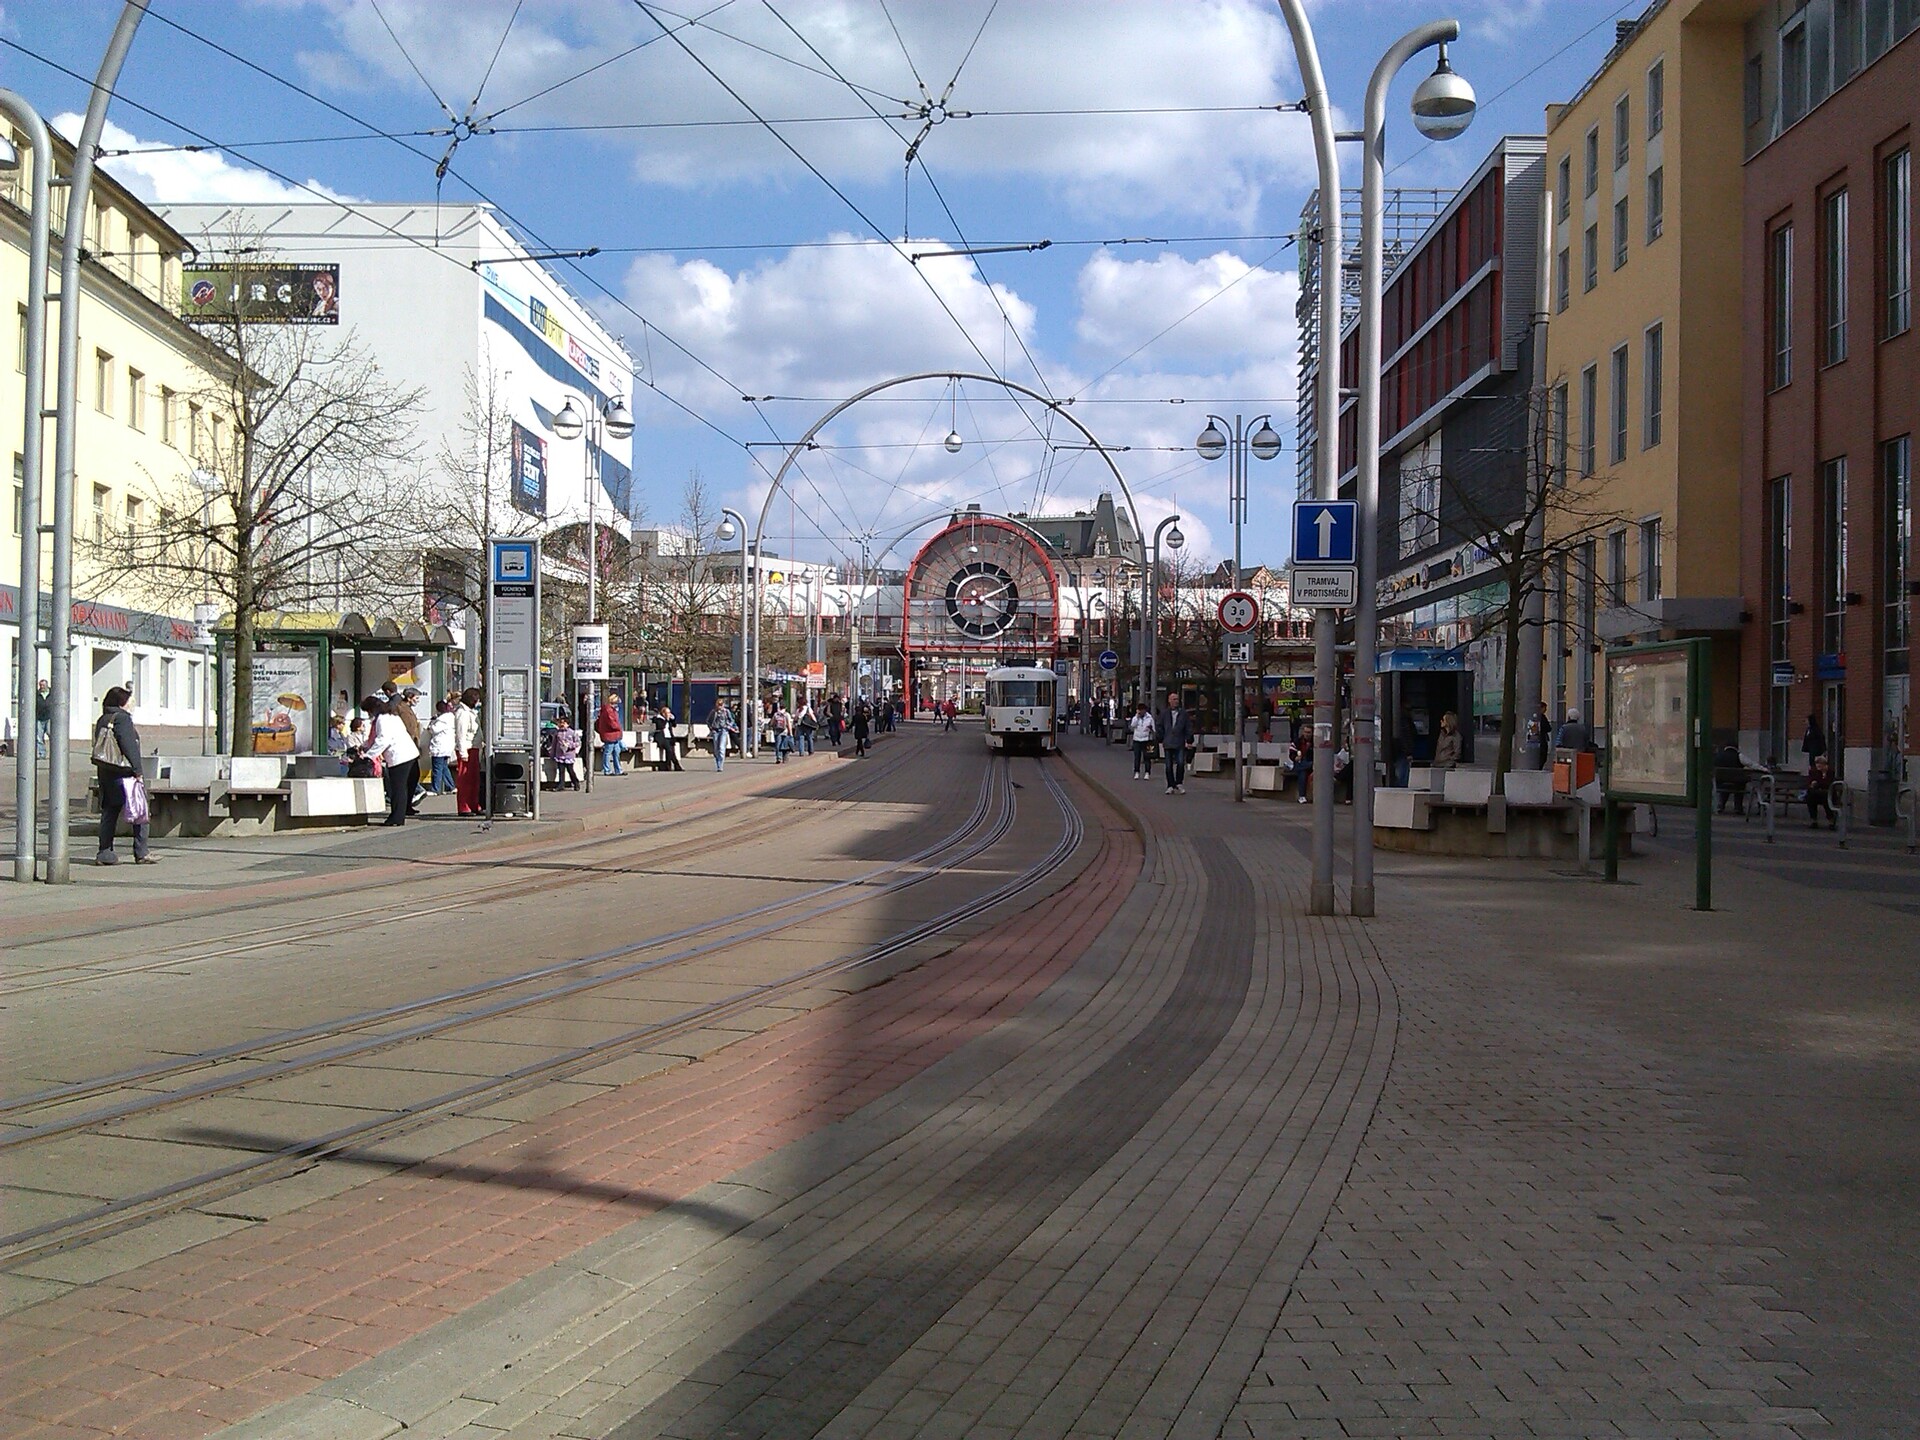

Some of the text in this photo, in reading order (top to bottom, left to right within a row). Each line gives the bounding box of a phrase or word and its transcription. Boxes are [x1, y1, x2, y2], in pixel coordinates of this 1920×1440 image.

[1307, 577, 1340, 586] TRAMVAJ
[1297, 587, 1349, 598] V PROTISMĚRU
